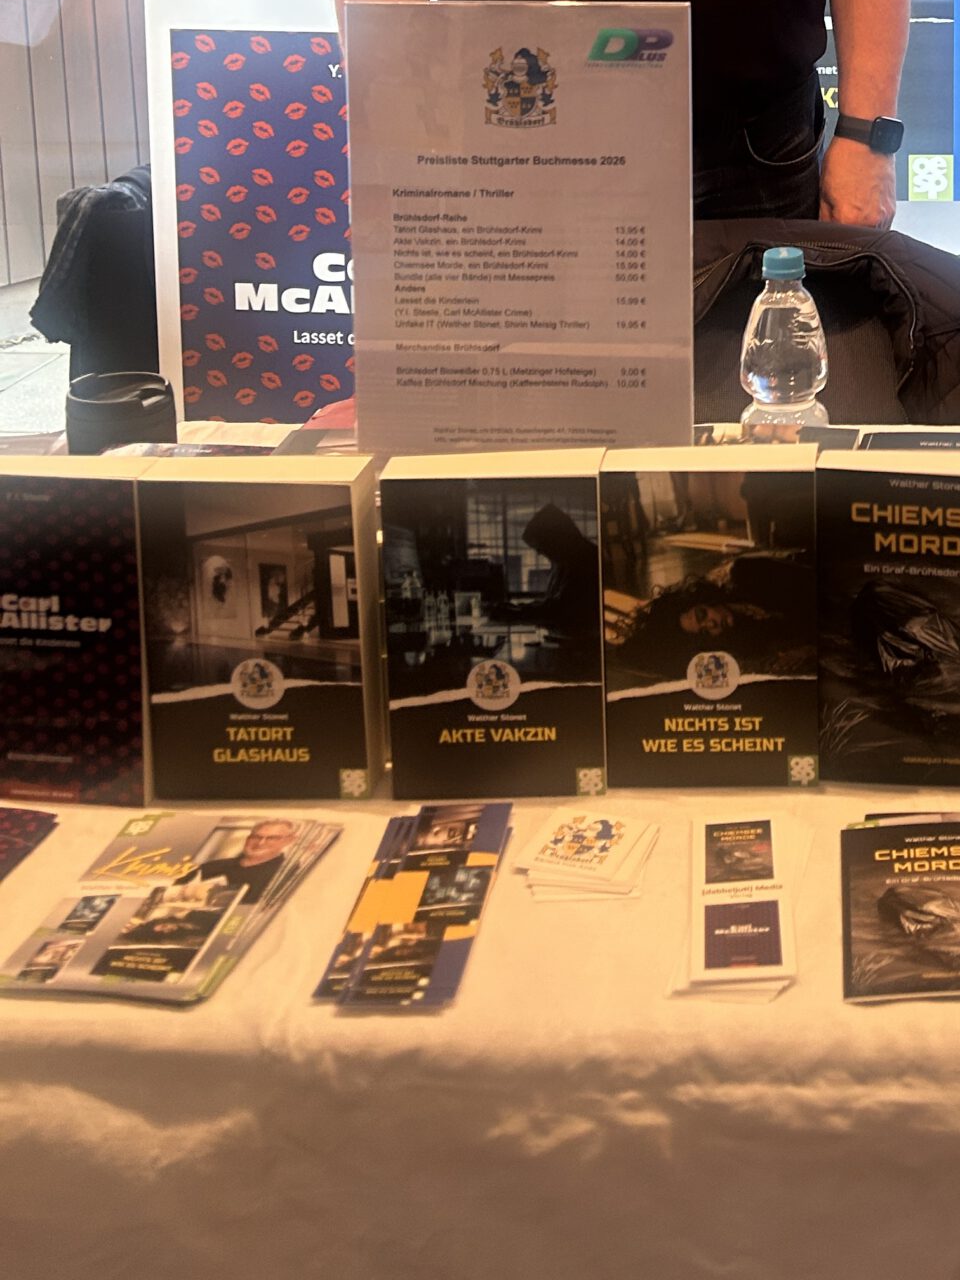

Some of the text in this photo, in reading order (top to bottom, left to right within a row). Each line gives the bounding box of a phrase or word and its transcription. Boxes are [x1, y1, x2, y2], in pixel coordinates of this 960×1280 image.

[417, 155, 469, 166] Preisliste
[471, 155, 530, 168] Stuttgarter
[533, 155, 597, 166] Buchmesse
[480, 189, 514, 198] Thriller
[293, 331, 343, 345] Lasset
[664, 717, 763, 732] NICHTS IST
[226, 727, 294, 741] TATORT
[439, 726, 557, 743] AKTE VAKZIN
[642, 737, 785, 752] WIE ES SCHEINT
[213, 748, 311, 762] GLASHAUS
